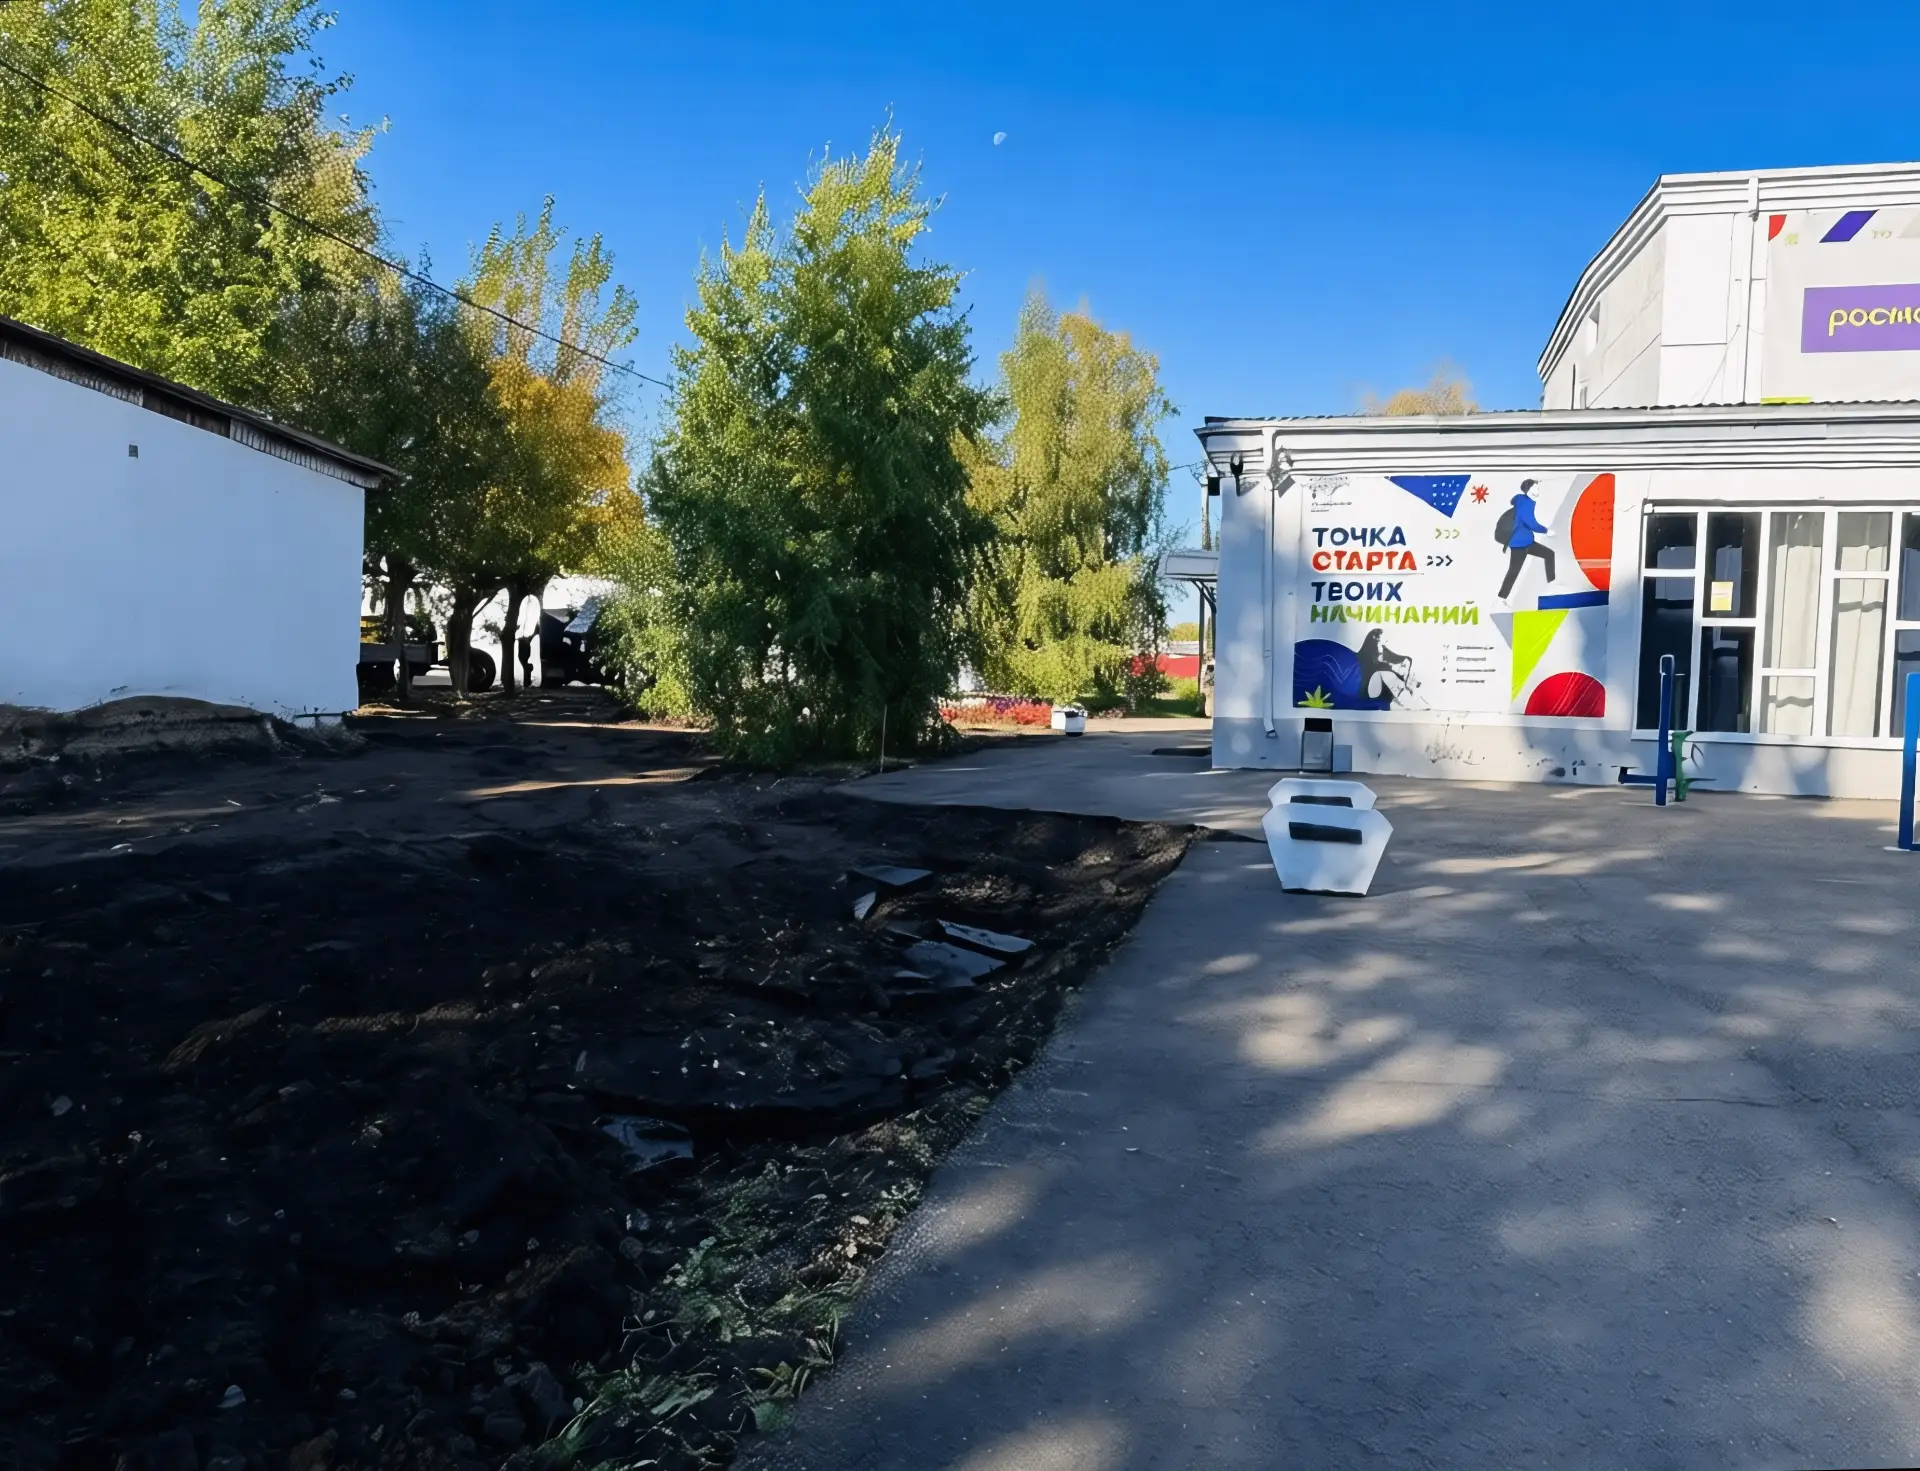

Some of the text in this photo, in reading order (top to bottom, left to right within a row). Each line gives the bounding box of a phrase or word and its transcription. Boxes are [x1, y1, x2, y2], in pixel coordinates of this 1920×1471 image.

[1312, 527, 1406, 547] ТОЧКА
[1312, 551, 1417, 571] СТАРТА
[1311, 581, 1403, 601] ТВОИХ
[1310, 601, 1478, 624] НАЧИНАНИЙ
